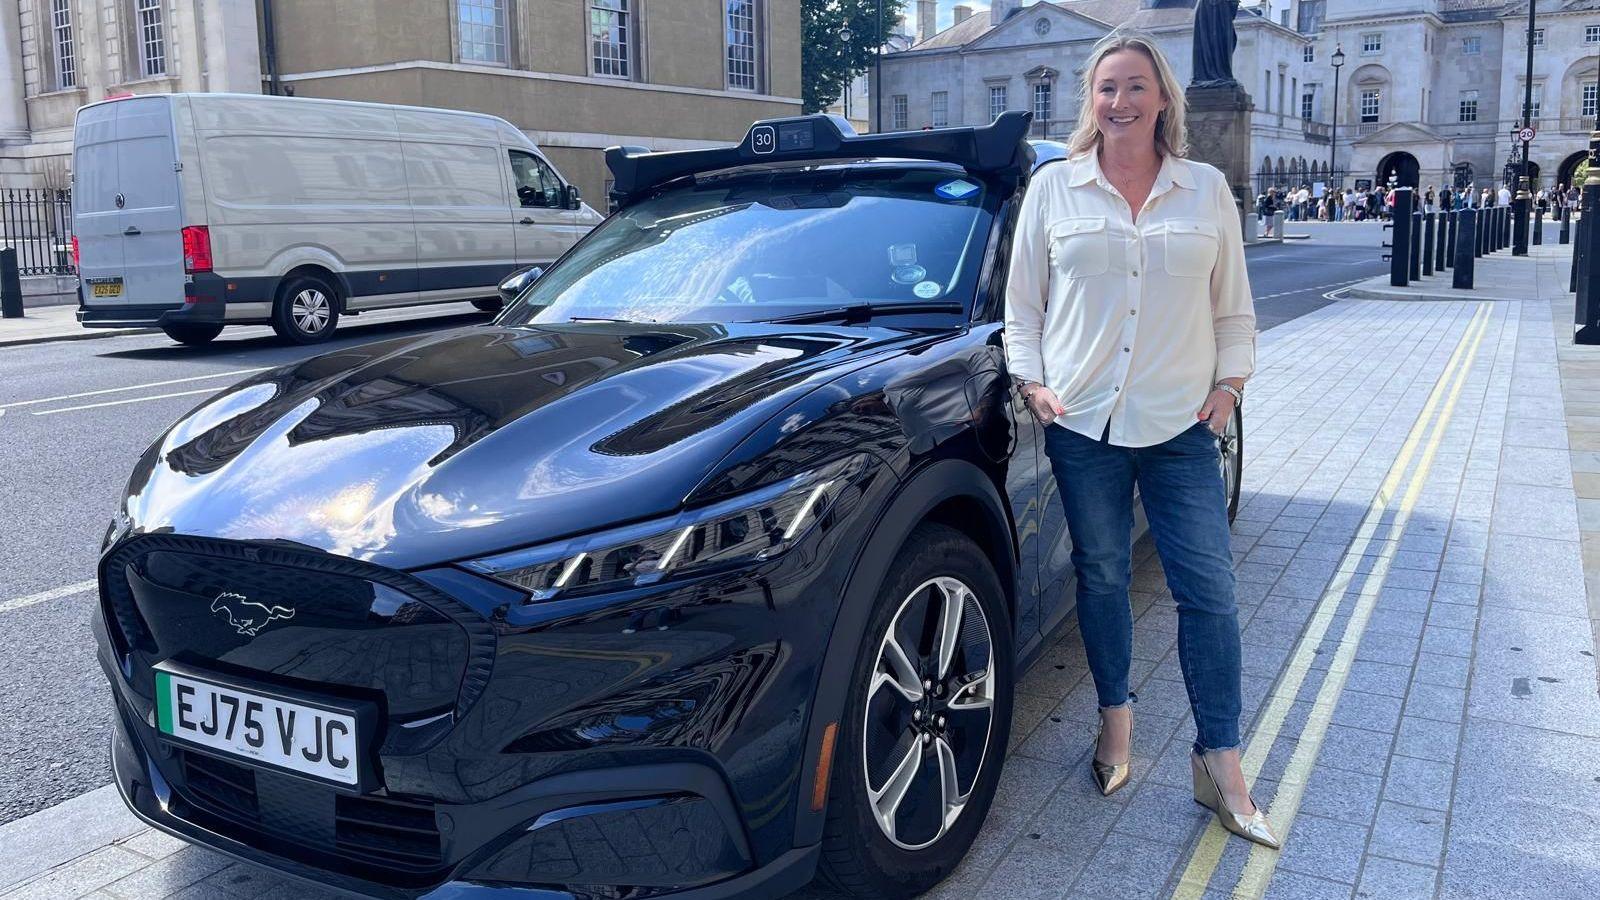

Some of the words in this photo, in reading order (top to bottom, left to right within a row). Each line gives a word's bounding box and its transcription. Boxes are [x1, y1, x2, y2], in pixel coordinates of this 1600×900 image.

[756, 133, 771, 146] 30
[177, 684, 265, 748] EJ75
[276, 707, 350, 769] VJC
